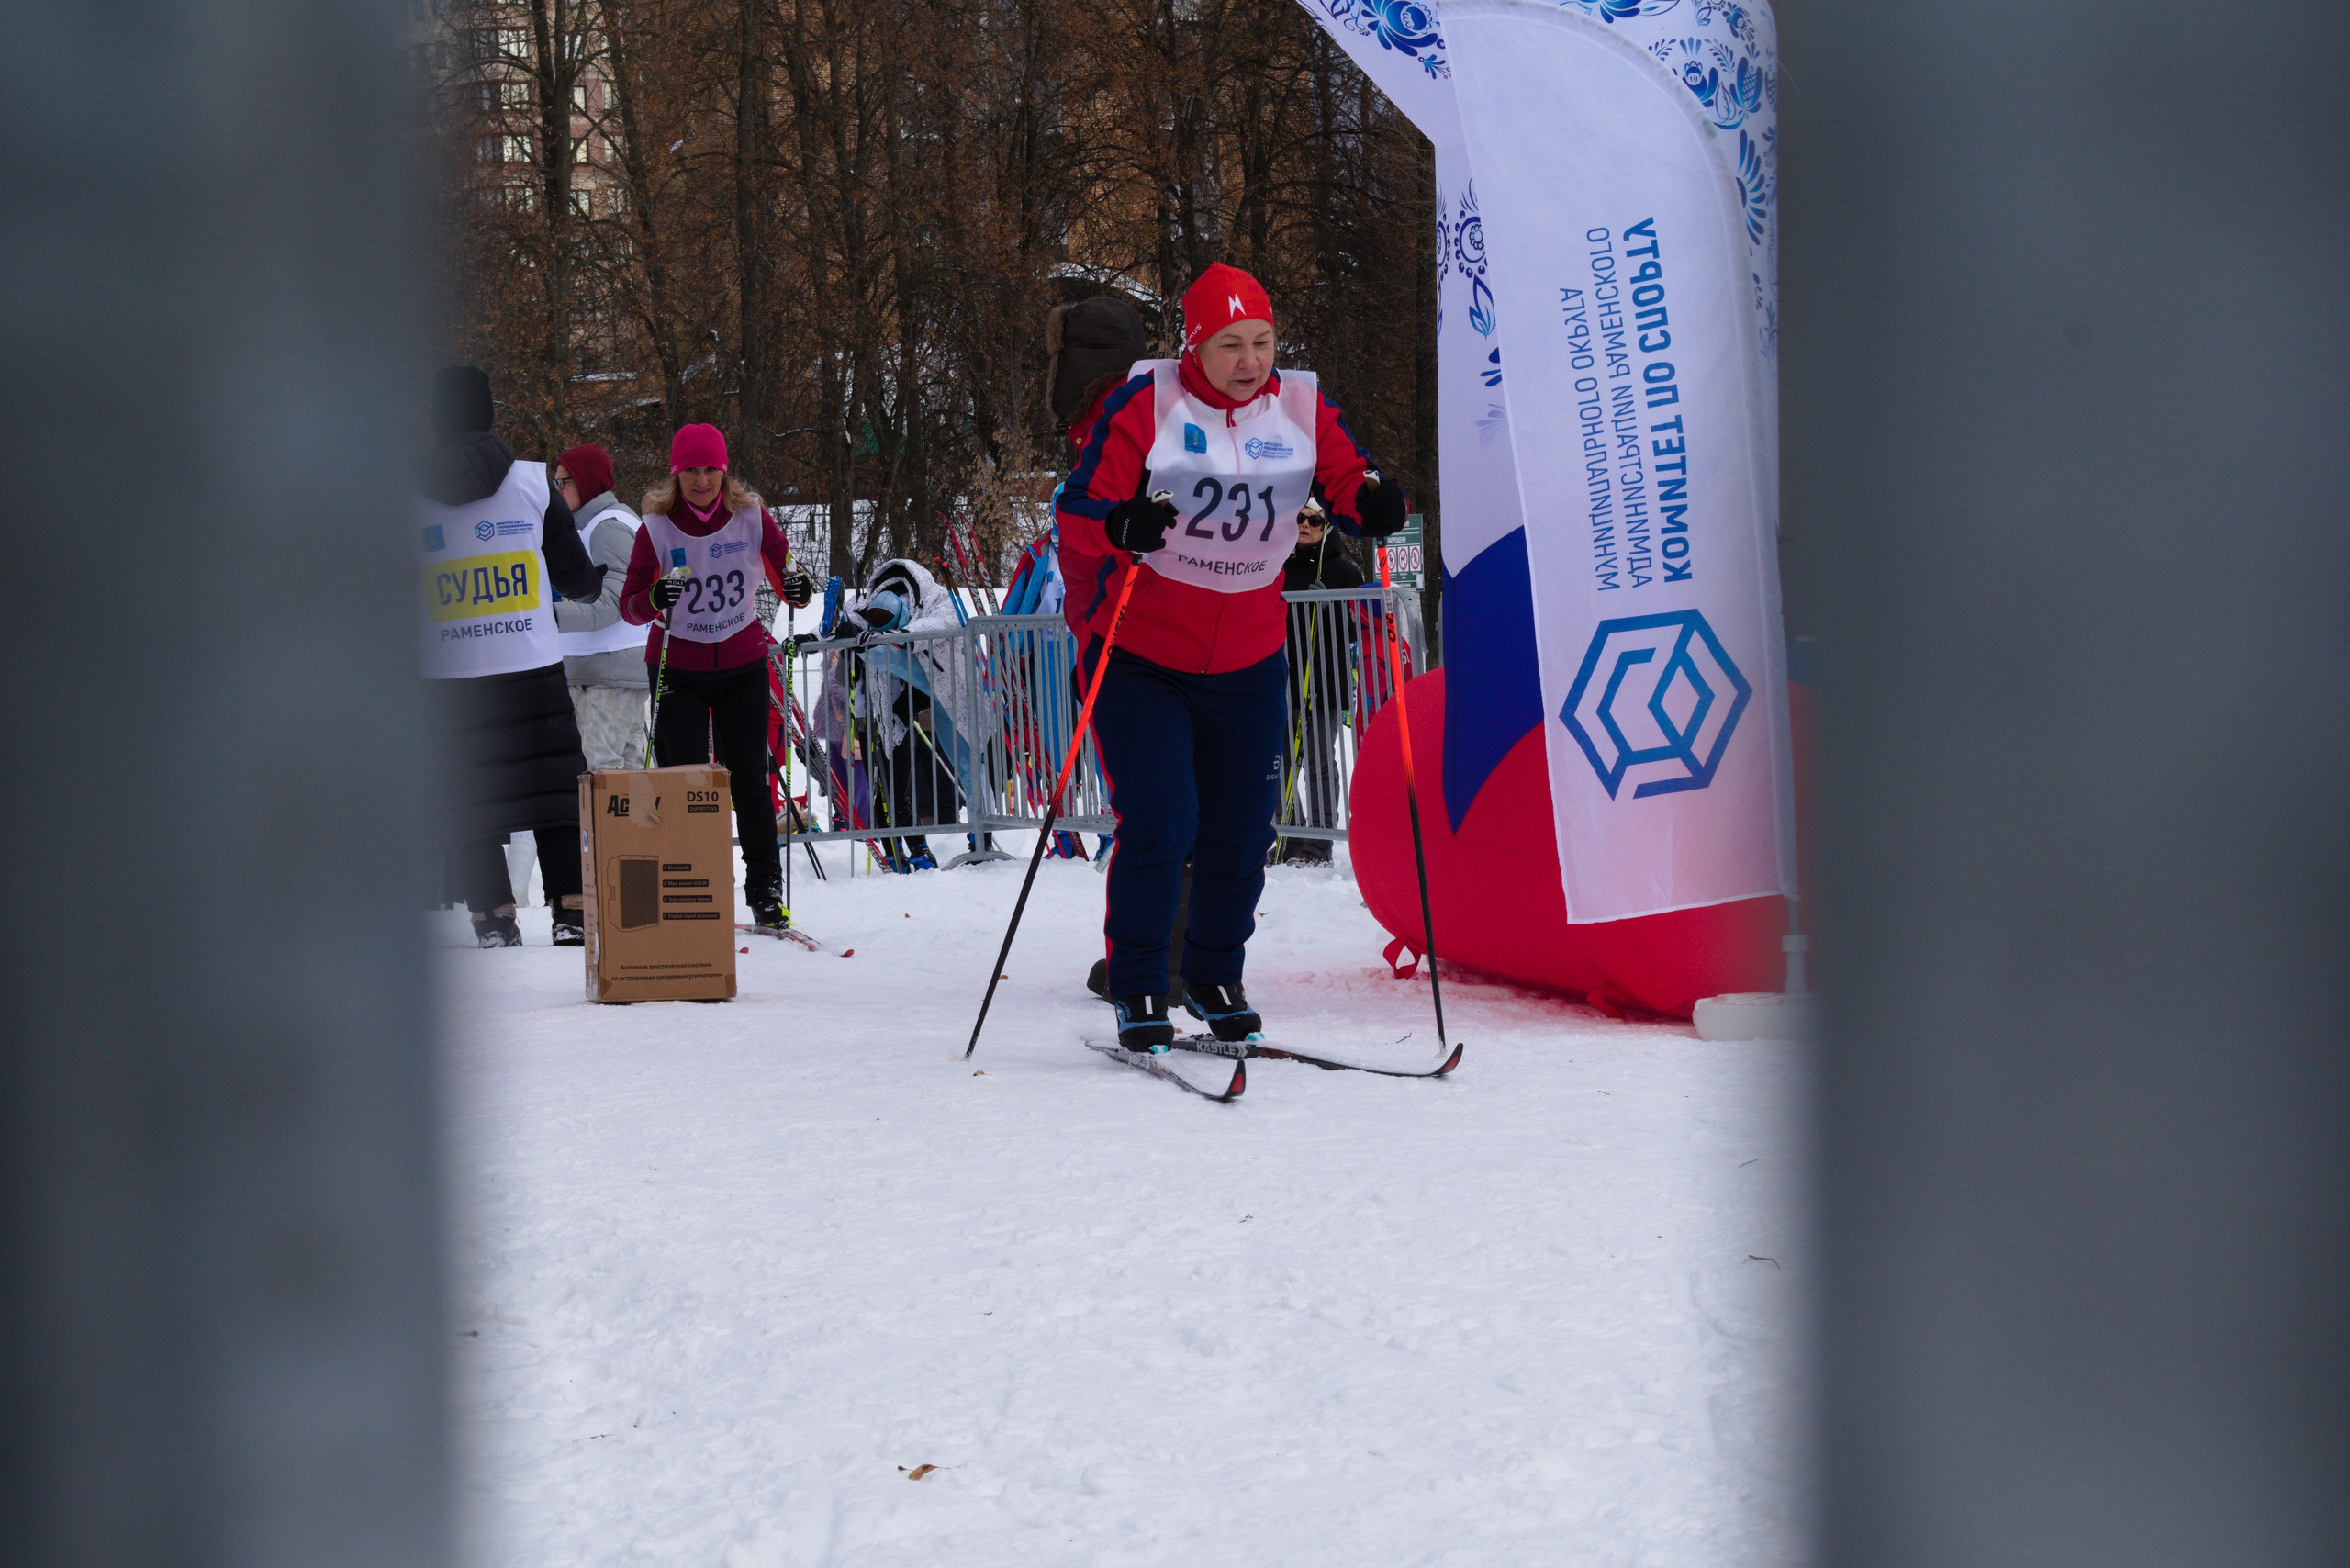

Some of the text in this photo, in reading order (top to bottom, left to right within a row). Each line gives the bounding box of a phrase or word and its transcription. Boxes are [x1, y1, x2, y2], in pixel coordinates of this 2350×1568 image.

[1185, 477, 1275, 542] 231
[1178, 554, 1268, 576] РАМЕНСКОЕ
[436, 563, 528, 606] СУДЬЯ
[684, 569, 744, 615] 233
[441, 618, 532, 641] РАМЕНСКОЕ
[687, 612, 744, 633] РАМЕНСКОЕ
[687, 791, 719, 802] DS10
